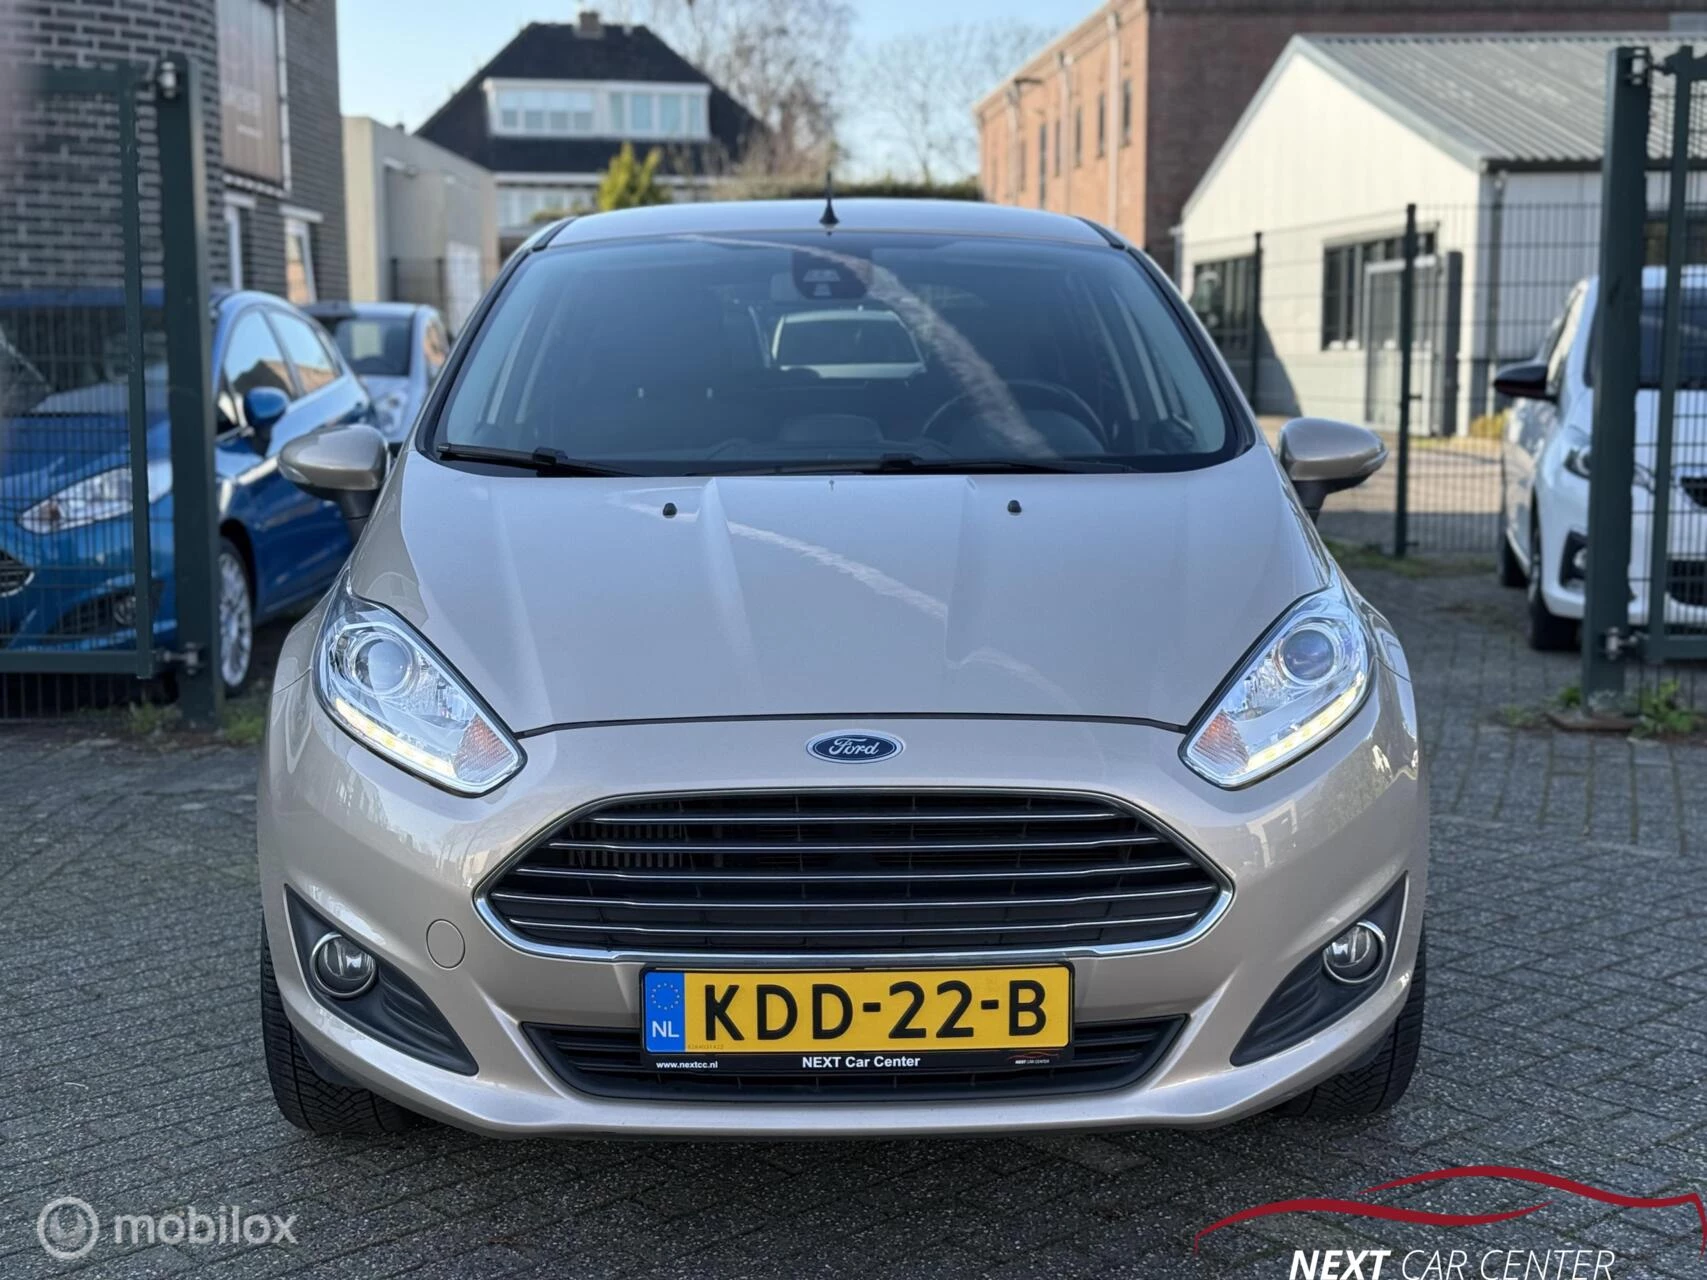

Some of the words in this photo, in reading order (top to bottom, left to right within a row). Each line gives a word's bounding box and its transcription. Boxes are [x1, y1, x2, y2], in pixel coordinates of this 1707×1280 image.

[828, 737, 880, 755] Ford
[705, 979, 1047, 1041] KDD-22-B
[652, 1020, 680, 1038] NL
[656, 1060, 719, 1069] www.nextcc.nl
[802, 1056, 842, 1068] NEXT
[845, 1056, 870, 1068] Car
[873, 1056, 921, 1067] Center
